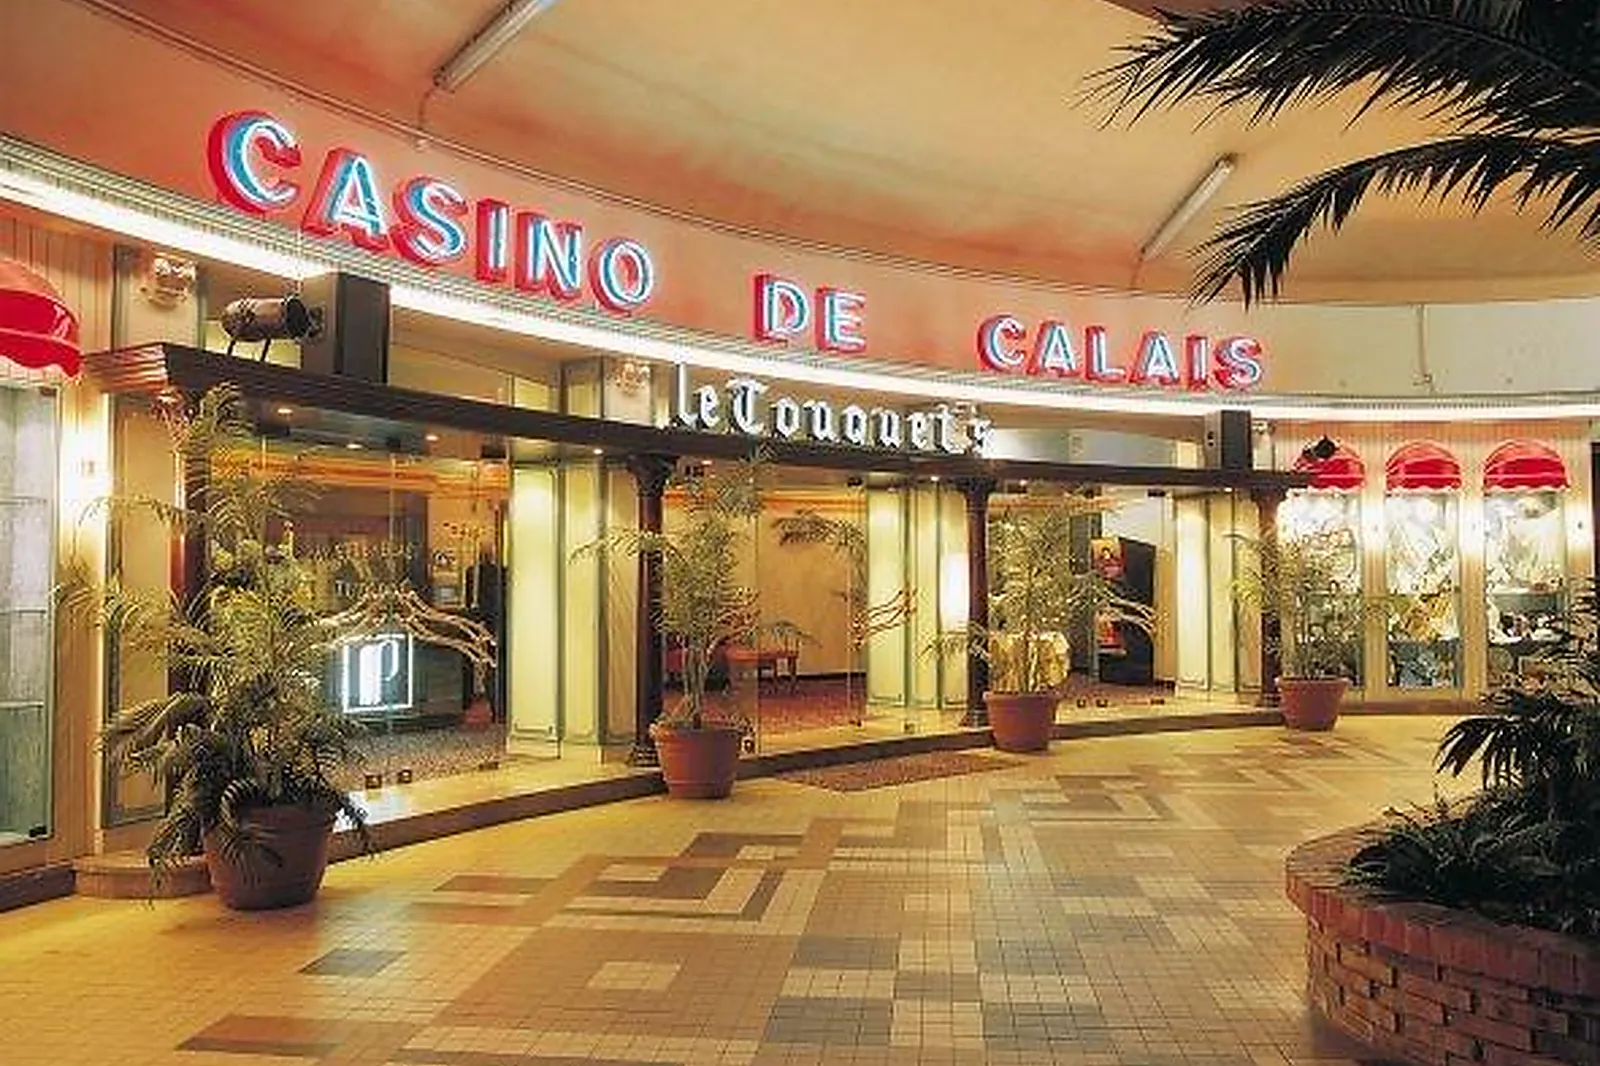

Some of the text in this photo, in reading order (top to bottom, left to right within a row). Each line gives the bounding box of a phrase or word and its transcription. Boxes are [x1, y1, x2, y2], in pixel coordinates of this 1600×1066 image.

[207, 110, 1266, 391] CASINO DE CALAIS
